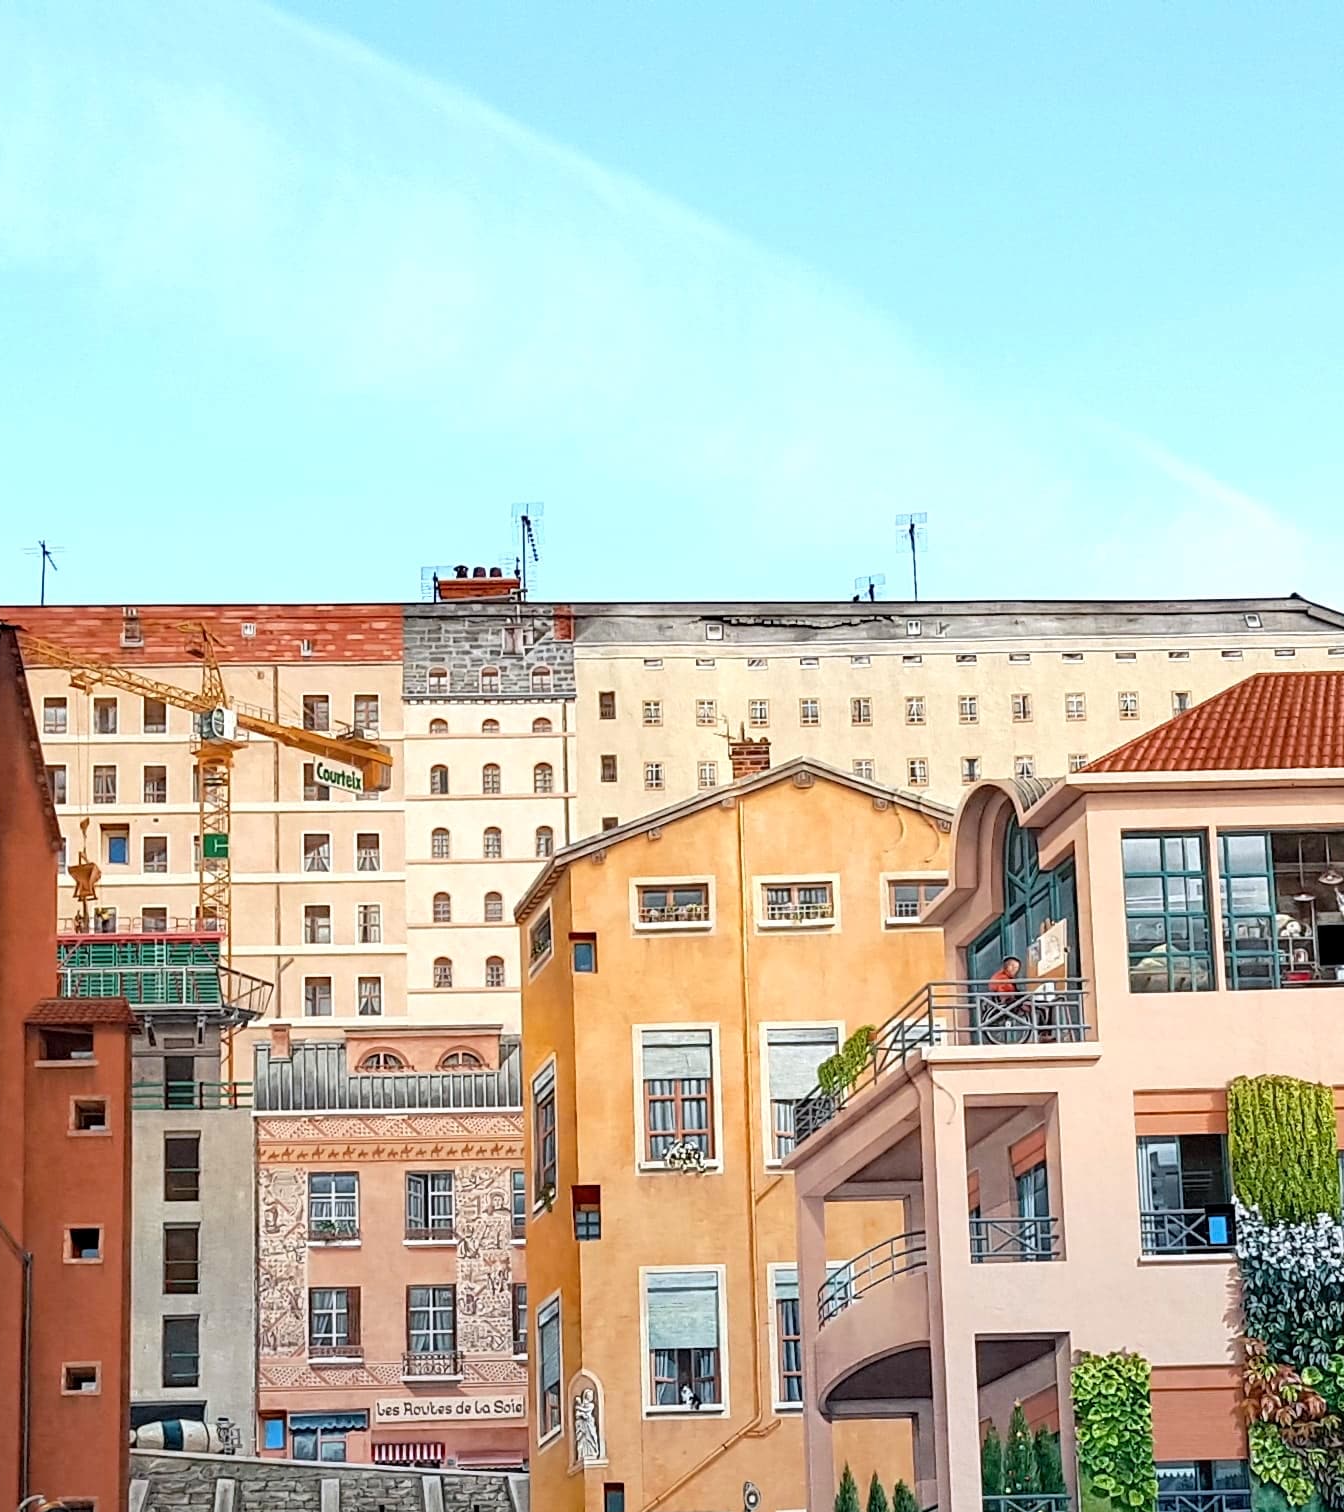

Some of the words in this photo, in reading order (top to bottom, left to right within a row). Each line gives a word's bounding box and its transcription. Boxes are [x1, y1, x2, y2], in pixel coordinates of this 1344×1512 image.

[316, 762, 362, 791] Courteix
[376, 1402, 400, 1417] Les
[403, 1401, 453, 1416] Routes
[455, 1400, 472, 1415] de
[493, 1398, 522, 1414] Soie
